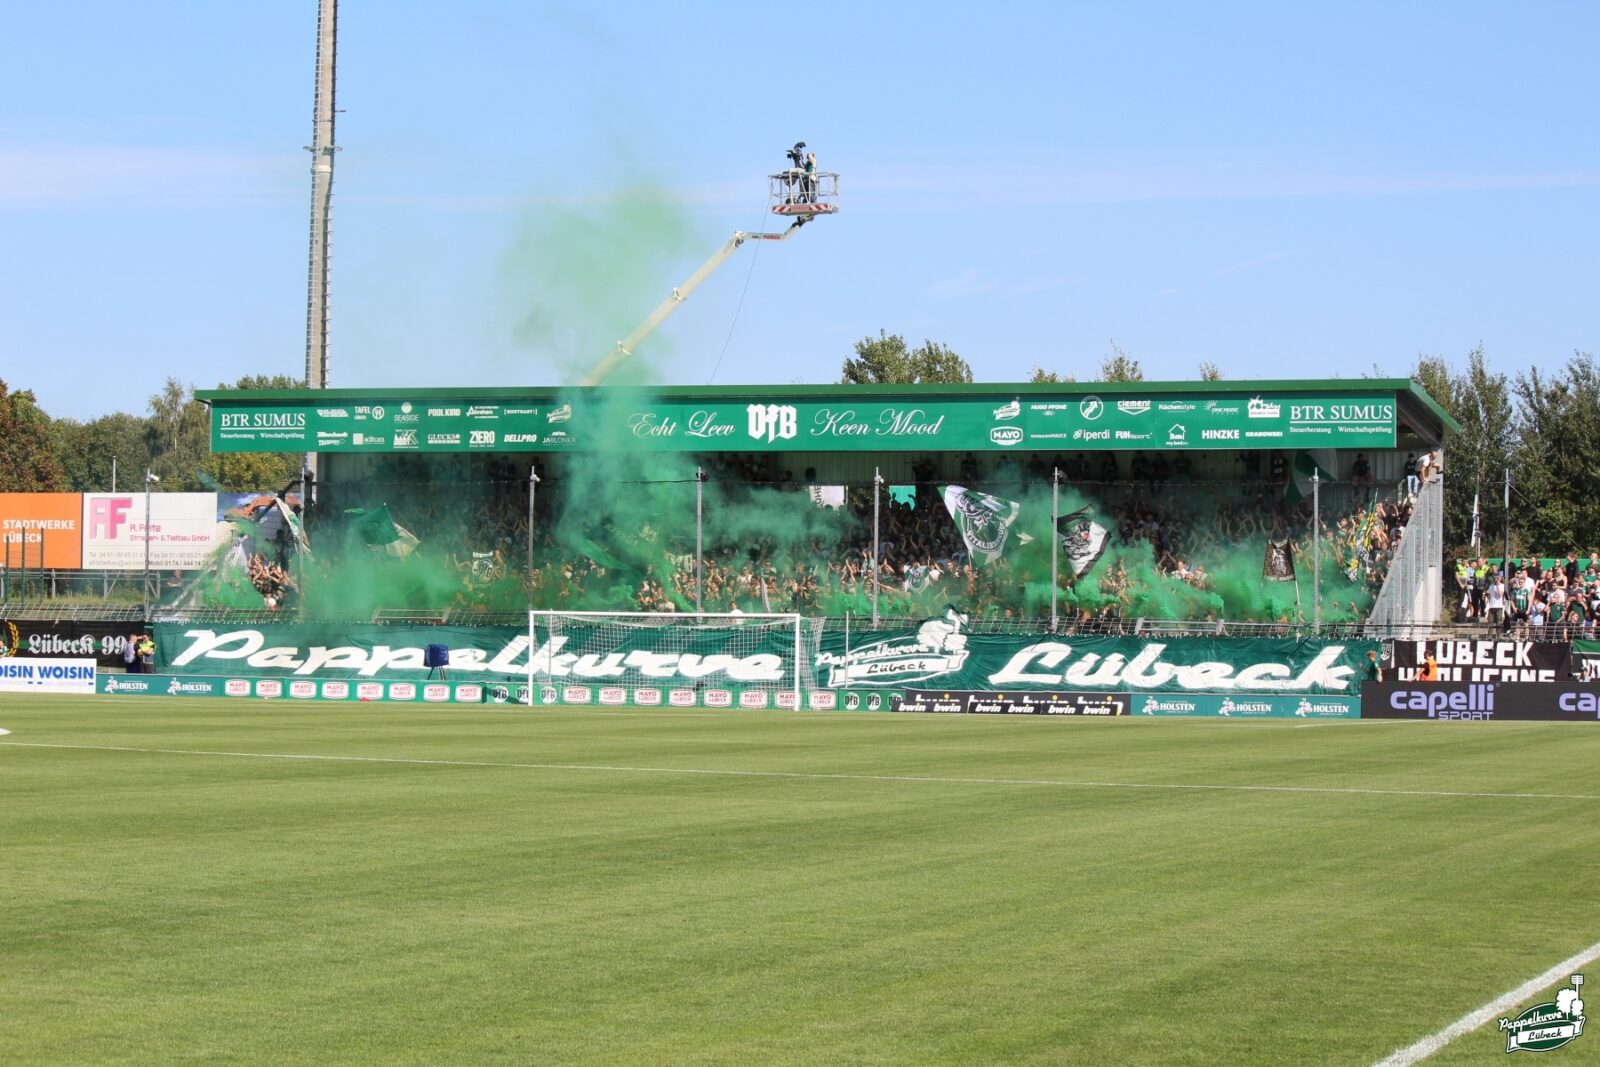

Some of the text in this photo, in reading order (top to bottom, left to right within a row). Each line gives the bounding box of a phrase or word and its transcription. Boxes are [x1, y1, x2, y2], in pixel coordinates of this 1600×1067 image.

[354, 406, 371, 414] TAFEL
[1290, 405, 1325, 420] BTR
[1330, 405, 1392, 420] SUMUS
[221, 414, 250, 427] BTR
[254, 413, 305, 427] SUMUS
[394, 414, 419, 422] SEASIDE
[810, 408, 945, 437] Keen Mood
[627, 412, 677, 439] Echt
[1289, 426, 1332, 434] Steuerberatung
[503, 434, 537, 443] DELLPRO
[993, 431, 1020, 439] MAYO
[1083, 429, 1110, 441] iperdi
[1201, 429, 1240, 439] HINZKE
[3, 520, 75, 529] STADTWERKE
[101, 635, 126, 655] 99
[172, 629, 786, 683] Pappelkurve
[814, 643, 930, 667] Pappelkurve
[866, 660, 926, 674] Lübeck
[988, 641, 1355, 690] Lübeck
[37, 666, 94, 680] WOISIN
[119, 682, 149, 690] HOLSTEN
[182, 684, 212, 692] HOLSTEN
[1390, 684, 1494, 718] capelli
[1558, 692, 1600, 719] ca
[898, 702, 961, 712] bwin bwin
[975, 703, 1034, 713] bwin bwin
[1048, 704, 1076, 714] bwin
[1083, 705, 1111, 715] bwin
[1159, 703, 1196, 712] HOLSTEN
[1236, 704, 1273, 712] HOLSTEN
[1313, 704, 1349, 713] HOLSTEN
[1438, 711, 1493, 720] SPORT
